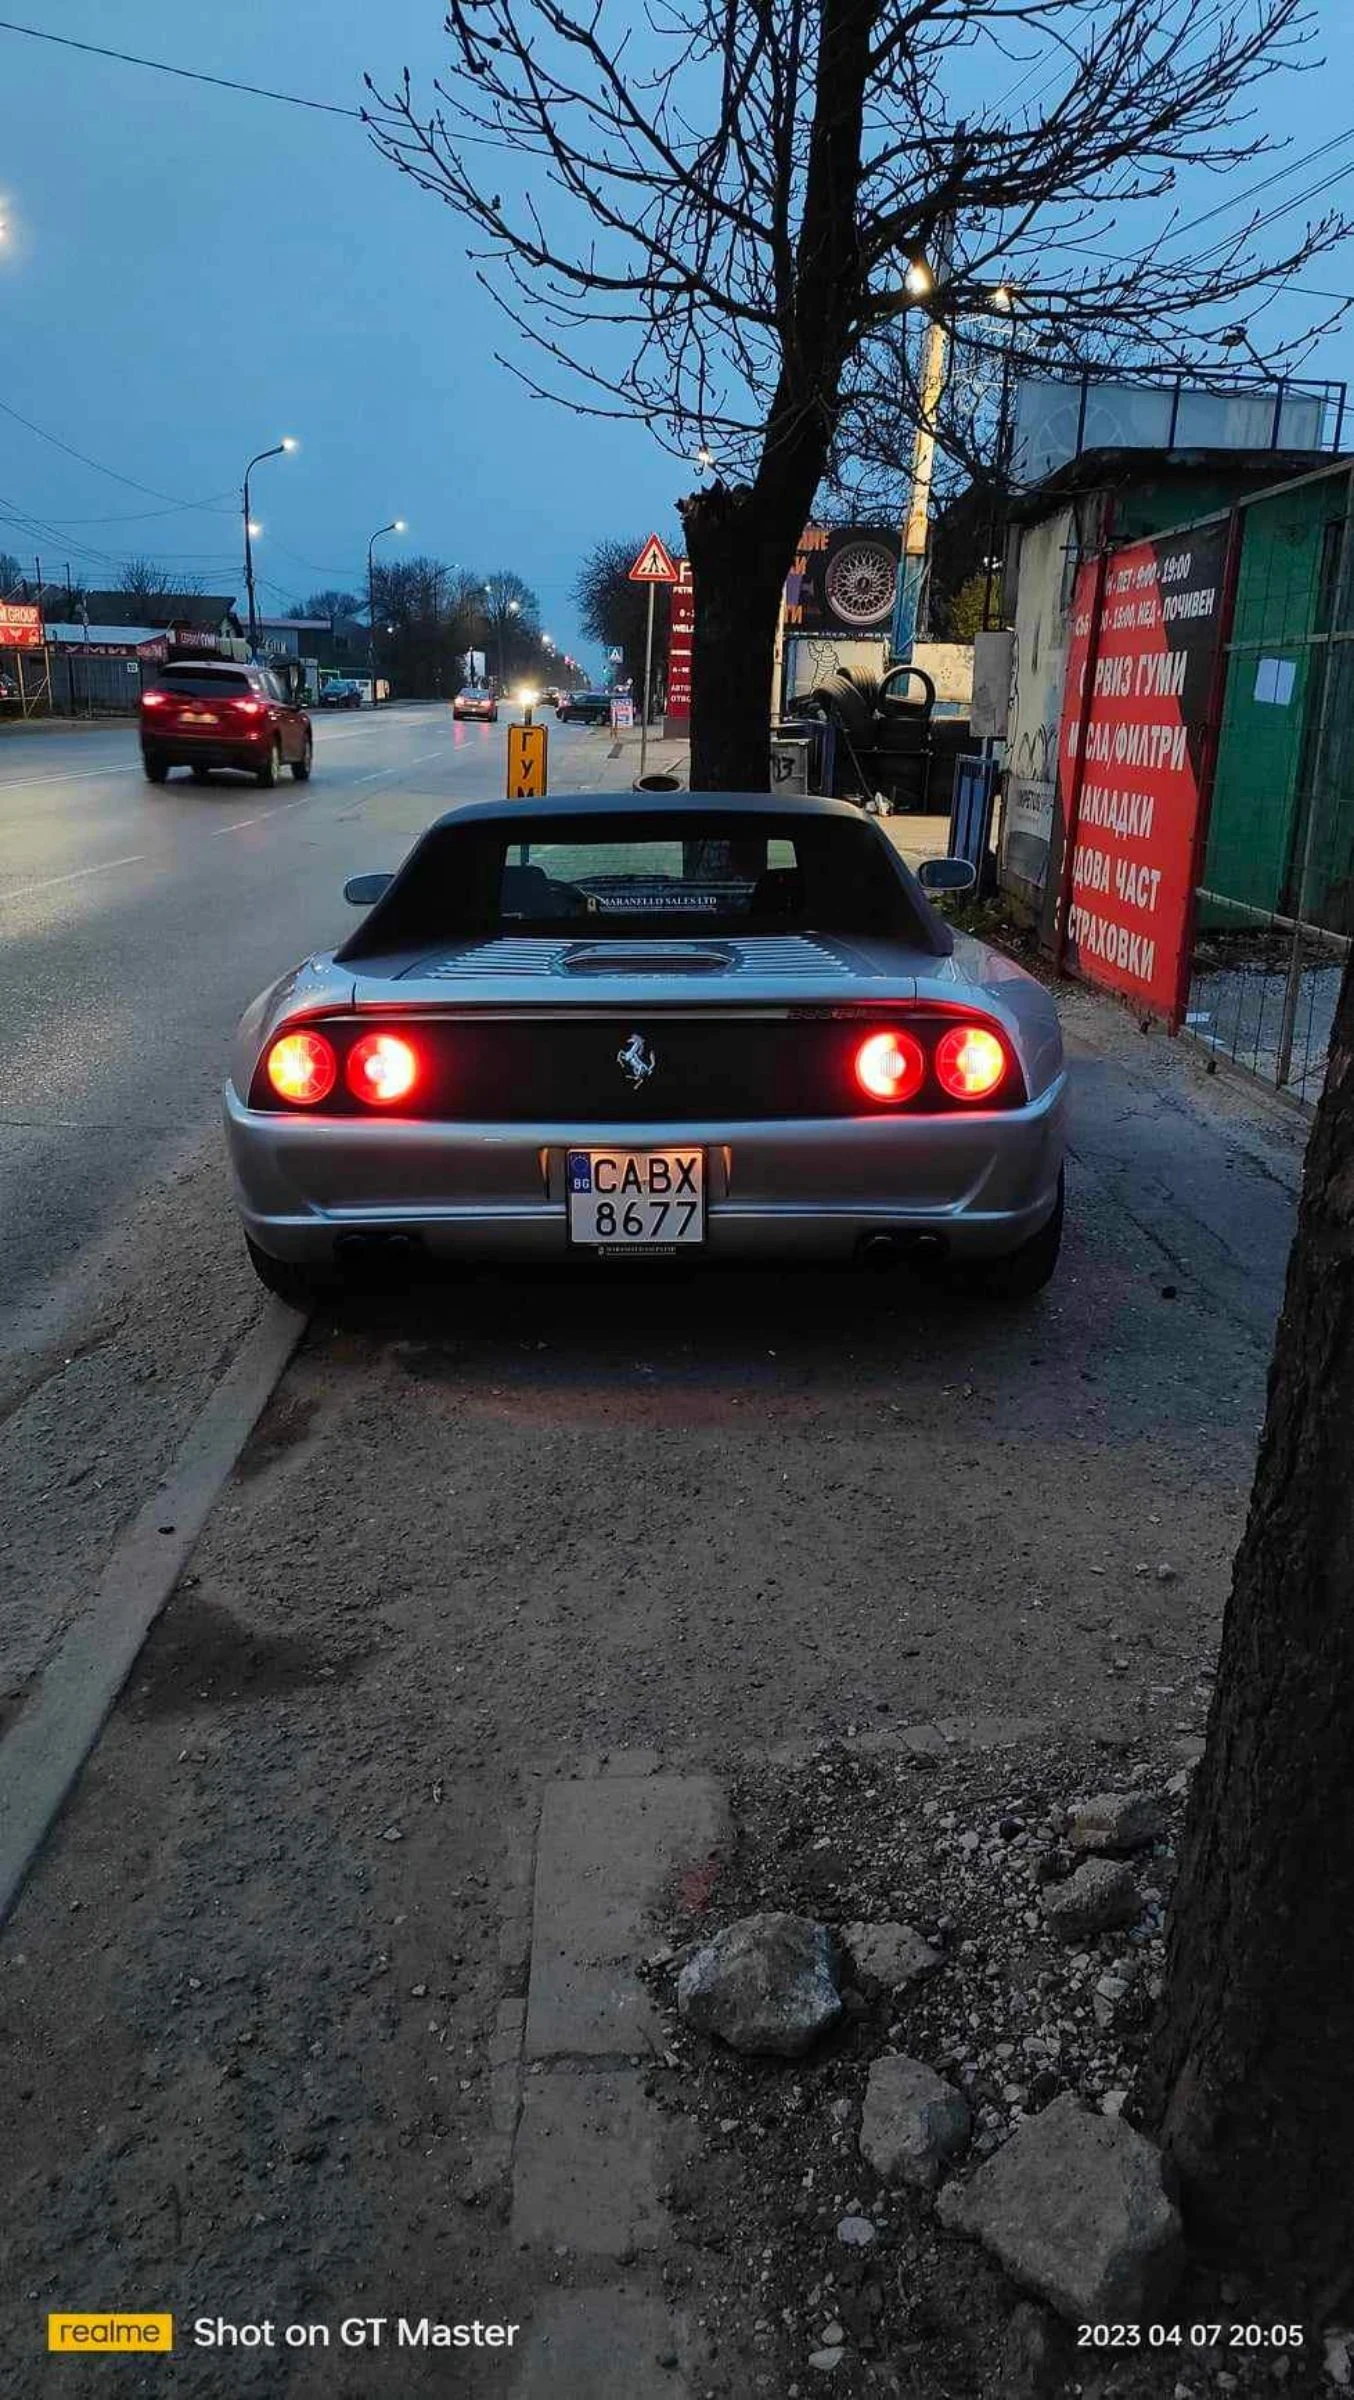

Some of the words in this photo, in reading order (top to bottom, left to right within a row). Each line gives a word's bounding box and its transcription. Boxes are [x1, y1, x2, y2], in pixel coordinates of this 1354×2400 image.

[1161, 553, 1191, 584] 19:00
[1163, 588, 1215, 621] ПОЧИВЕН
[1080, 655, 1134, 697] РВИЗ
[1135, 651, 1188, 696] ГУМИ
[1068, 720, 1188, 771] МСЛА/ФИЛТРИ
[698, 896, 717, 905] LTD
[1115, 858, 1161, 912] ЧАСТ
[1055, 896, 1155, 982] СТРАХОВКИ
[574, 1178, 590, 1190] BG
[594, 1158, 698, 1194] CABX
[596, 1201, 698, 1236] 8677
